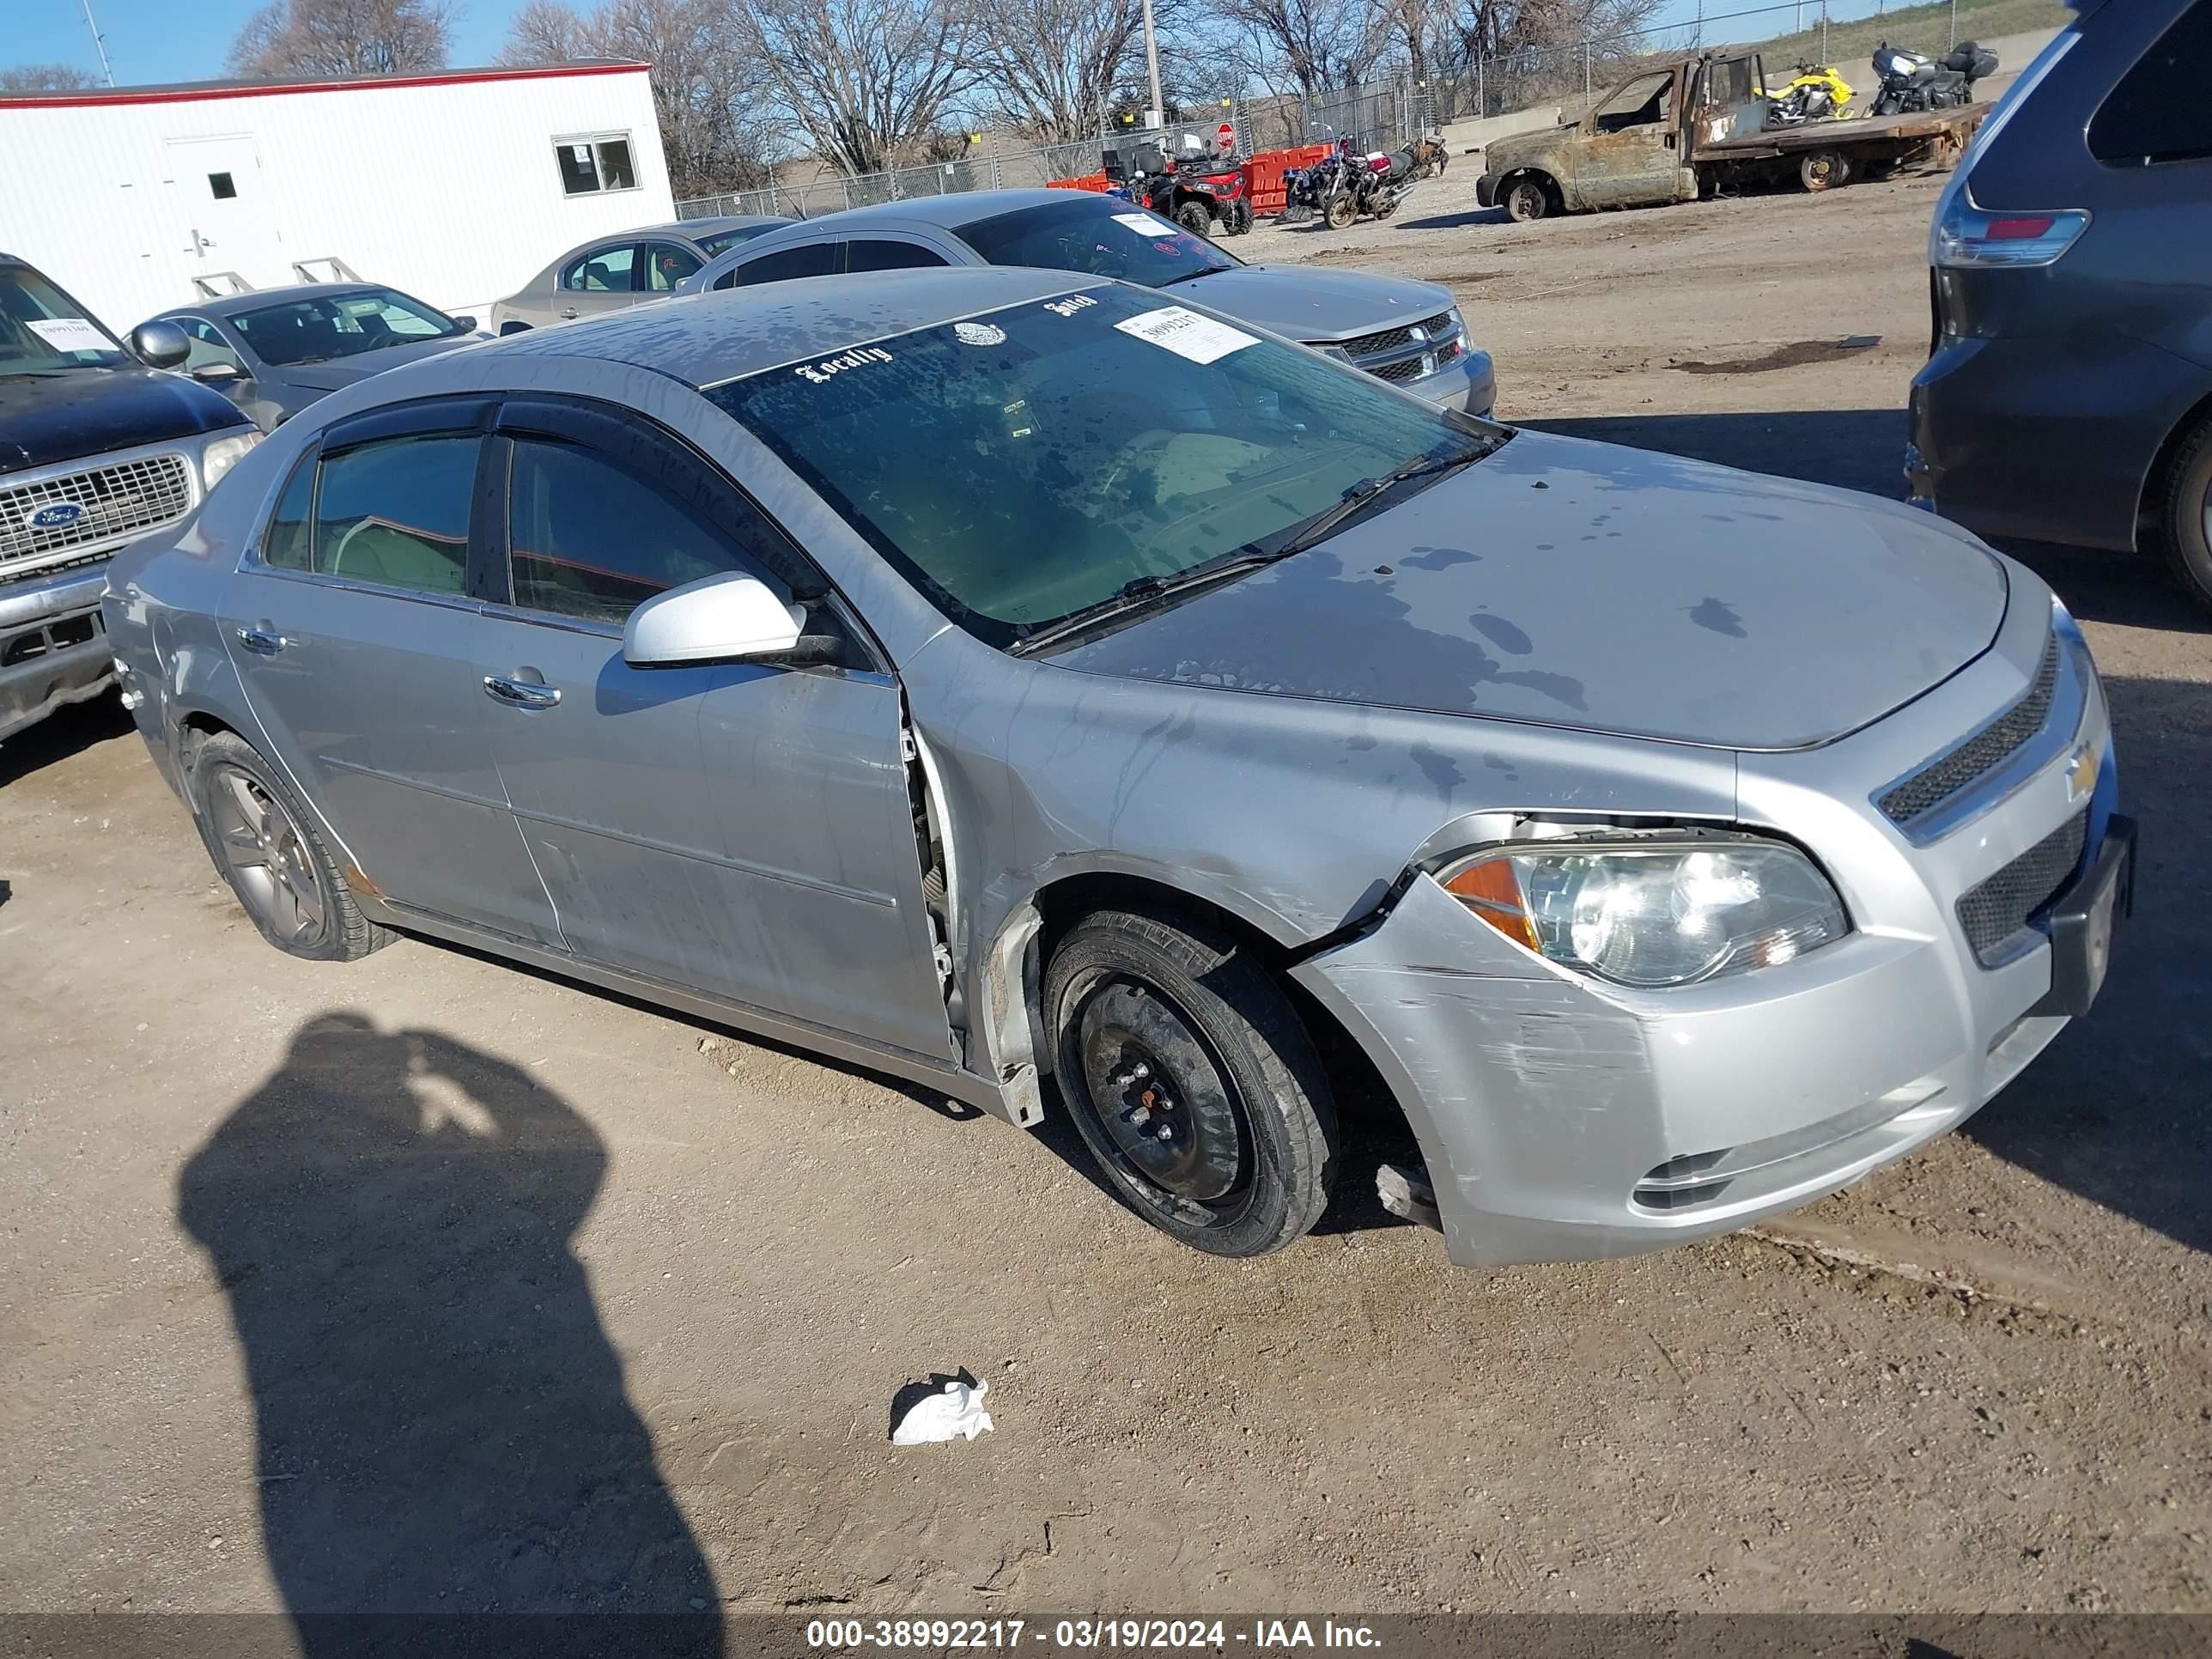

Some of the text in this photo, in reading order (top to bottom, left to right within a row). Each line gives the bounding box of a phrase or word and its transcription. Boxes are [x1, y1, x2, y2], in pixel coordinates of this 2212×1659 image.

[1218, 131, 1233, 143] STOP
[1141, 314, 1201, 339] 38992217
[794, 348, 893, 384] Locally
